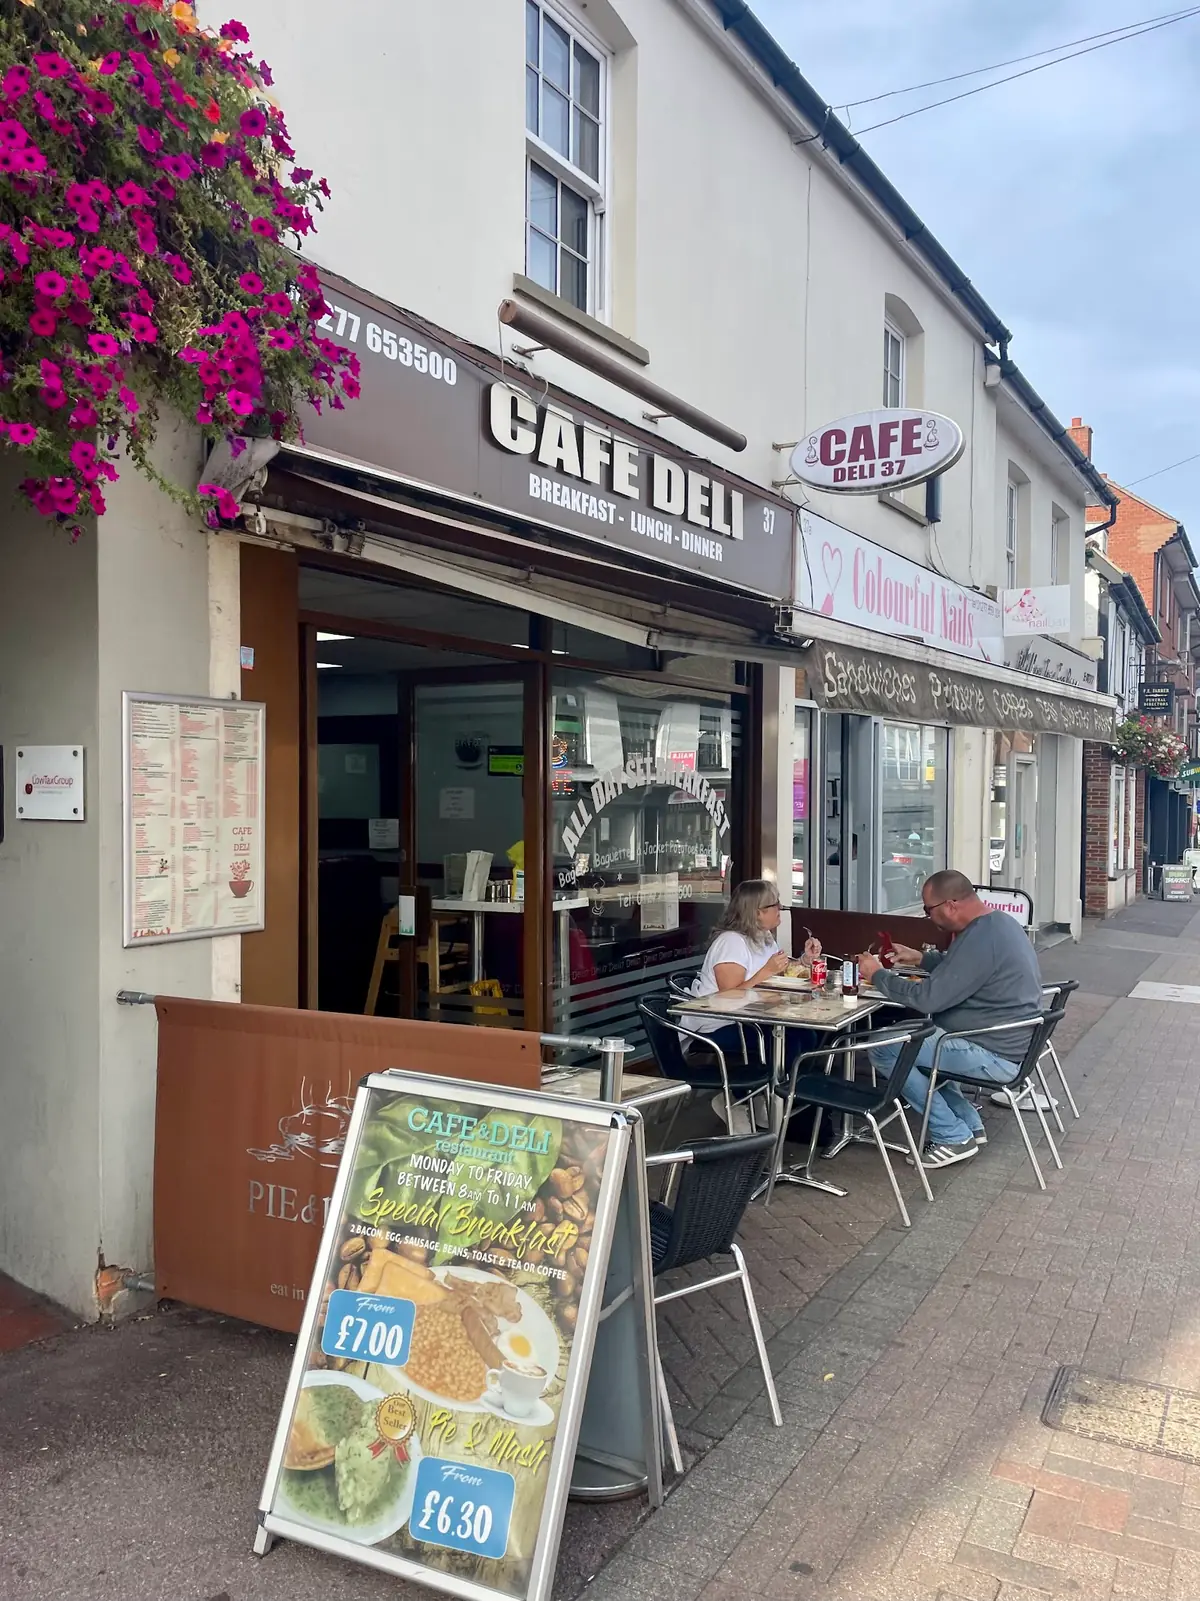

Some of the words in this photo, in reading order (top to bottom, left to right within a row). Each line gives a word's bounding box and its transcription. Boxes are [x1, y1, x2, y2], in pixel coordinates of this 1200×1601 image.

[366, 322, 458, 386] 653500
[490, 383, 640, 500] CAFE
[652, 452, 744, 541] DELI
[819, 417, 922, 468] CAFE
[833, 463, 875, 483] DELI
[880, 459, 905, 478] 37
[529, 472, 616, 525] BREAKFAST
[630, 512, 672, 545] LUNCH
[681, 532, 723, 562] DINNER
[762, 507, 776, 536] 37
[852, 547, 936, 634] Colourful
[940, 585, 974, 649] Nails
[824, 651, 916, 705] Sandwiches
[562, 799, 593, 859] ALL
[591, 768, 623, 814] DAY
[655, 757, 731, 838] BREAKFAST
[232, 827, 253, 835] CAFE
[233, 843, 251, 852] DELI
[435, 1139, 516, 1164] restaurant
[397, 1171, 456, 1196] BETWEEN
[410, 1154, 464, 1176] MONDAY
[468, 1165, 484, 1180] TO
[486, 1169, 533, 1190] FRIDAY
[360, 1187, 451, 1233] Special
[448, 1203, 578, 1258] Breakfast
[350, 1225, 355, 1233] 2
[356, 1225, 384, 1241] BACON,
[385, 1231, 403, 1245] EGG,
[403, 1236, 441, 1252] SAUSAGE,
[442, 1245, 470, 1259] BEANS,
[472, 1250, 497, 1264] TOAST
[498, 1256, 505, 1266] &
[506, 1258, 522, 1271] TEA
[523, 1263, 536, 1274] OR
[537, 1266, 568, 1281] COFFEE
[270, 1283, 289, 1296] eat
[292, 1284, 304, 1300] in
[356, 1298, 396, 1314] From
[334, 1315, 403, 1359] £7.00
[383, 1416, 408, 1430] Seller
[388, 1404, 406, 1417] Best
[428, 1409, 455, 1443] Pie
[463, 1421, 483, 1450] &
[488, 1432, 547, 1475] Mash
[441, 1465, 484, 1487] From
[418, 1490, 493, 1544] £6.30
